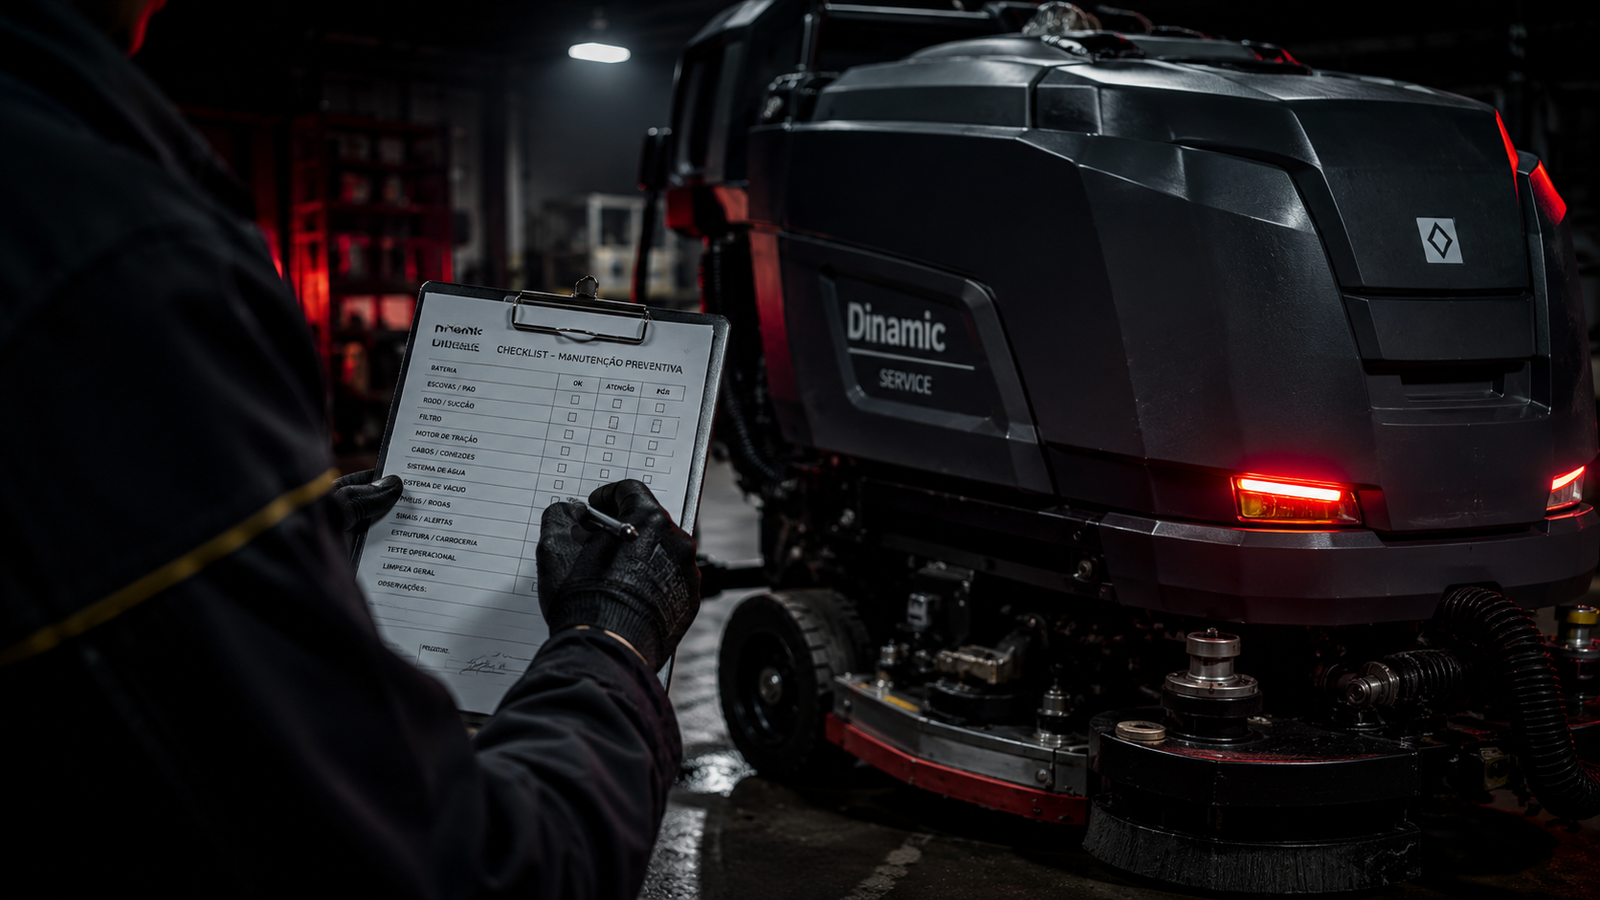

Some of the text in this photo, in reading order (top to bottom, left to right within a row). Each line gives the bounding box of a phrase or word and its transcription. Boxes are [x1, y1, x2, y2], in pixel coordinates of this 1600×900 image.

[847, 302, 946, 352] Dinamic
[497, 345, 549, 359] CHECKLIST
[625, 359, 683, 374] PREVENTIVA
[430, 364, 457, 374] BATERIA
[427, 381, 456, 390] ESCOVAS
[879, 368, 933, 395] SERVICE
[419, 413, 442, 423] FILTRO
[415, 430, 440, 439] MOTOR
[411, 446, 434, 455] CABOS
[407, 463, 436, 472] SISTEMA
[437, 466, 446, 474] DE
[424, 516, 453, 526] ALERTAS
[391, 529, 430, 540] ESTRUTURA
[435, 535, 478, 546] CARROCERIA
[388, 546, 457, 561] TESTE OPERACIONAL
[382, 563, 435, 576] LIMPEZA GERAL
